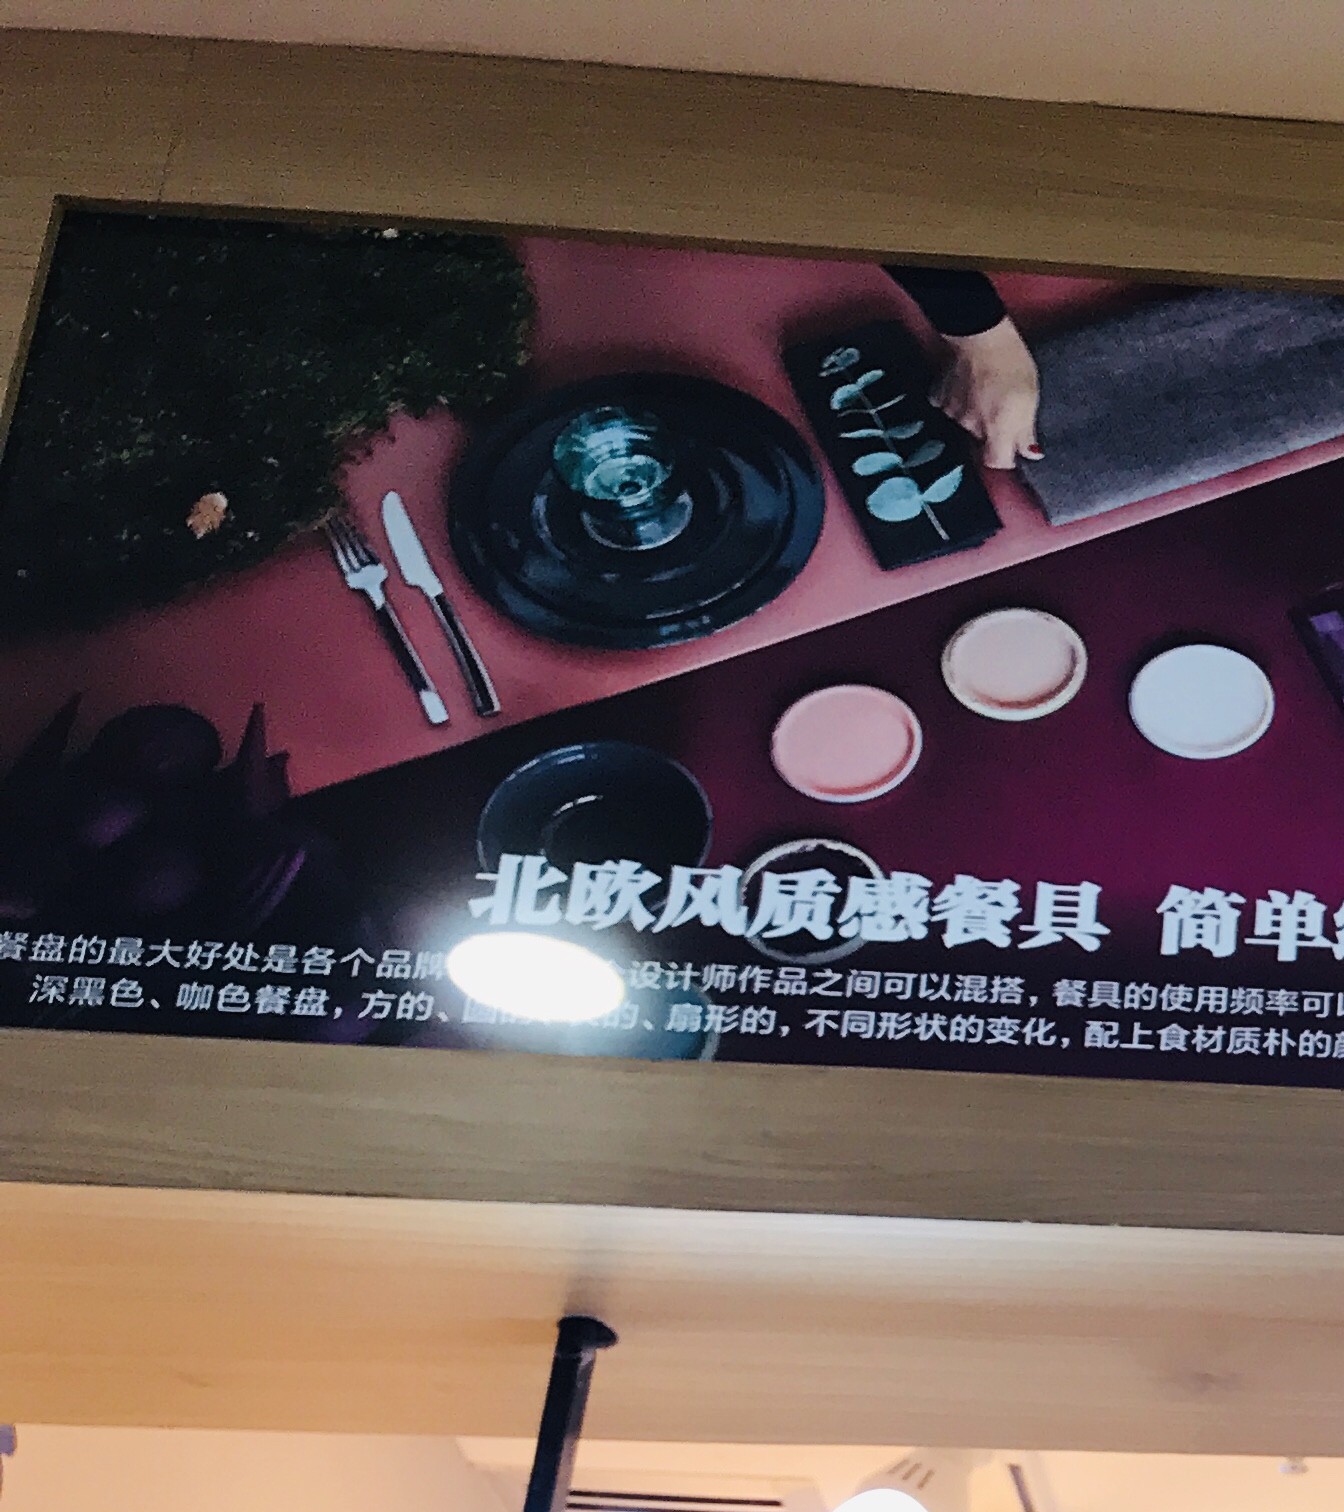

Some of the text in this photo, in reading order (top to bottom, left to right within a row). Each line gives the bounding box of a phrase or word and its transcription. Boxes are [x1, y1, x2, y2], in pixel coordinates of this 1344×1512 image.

[470, 854, 1110, 953] 北欧风质感餐具
